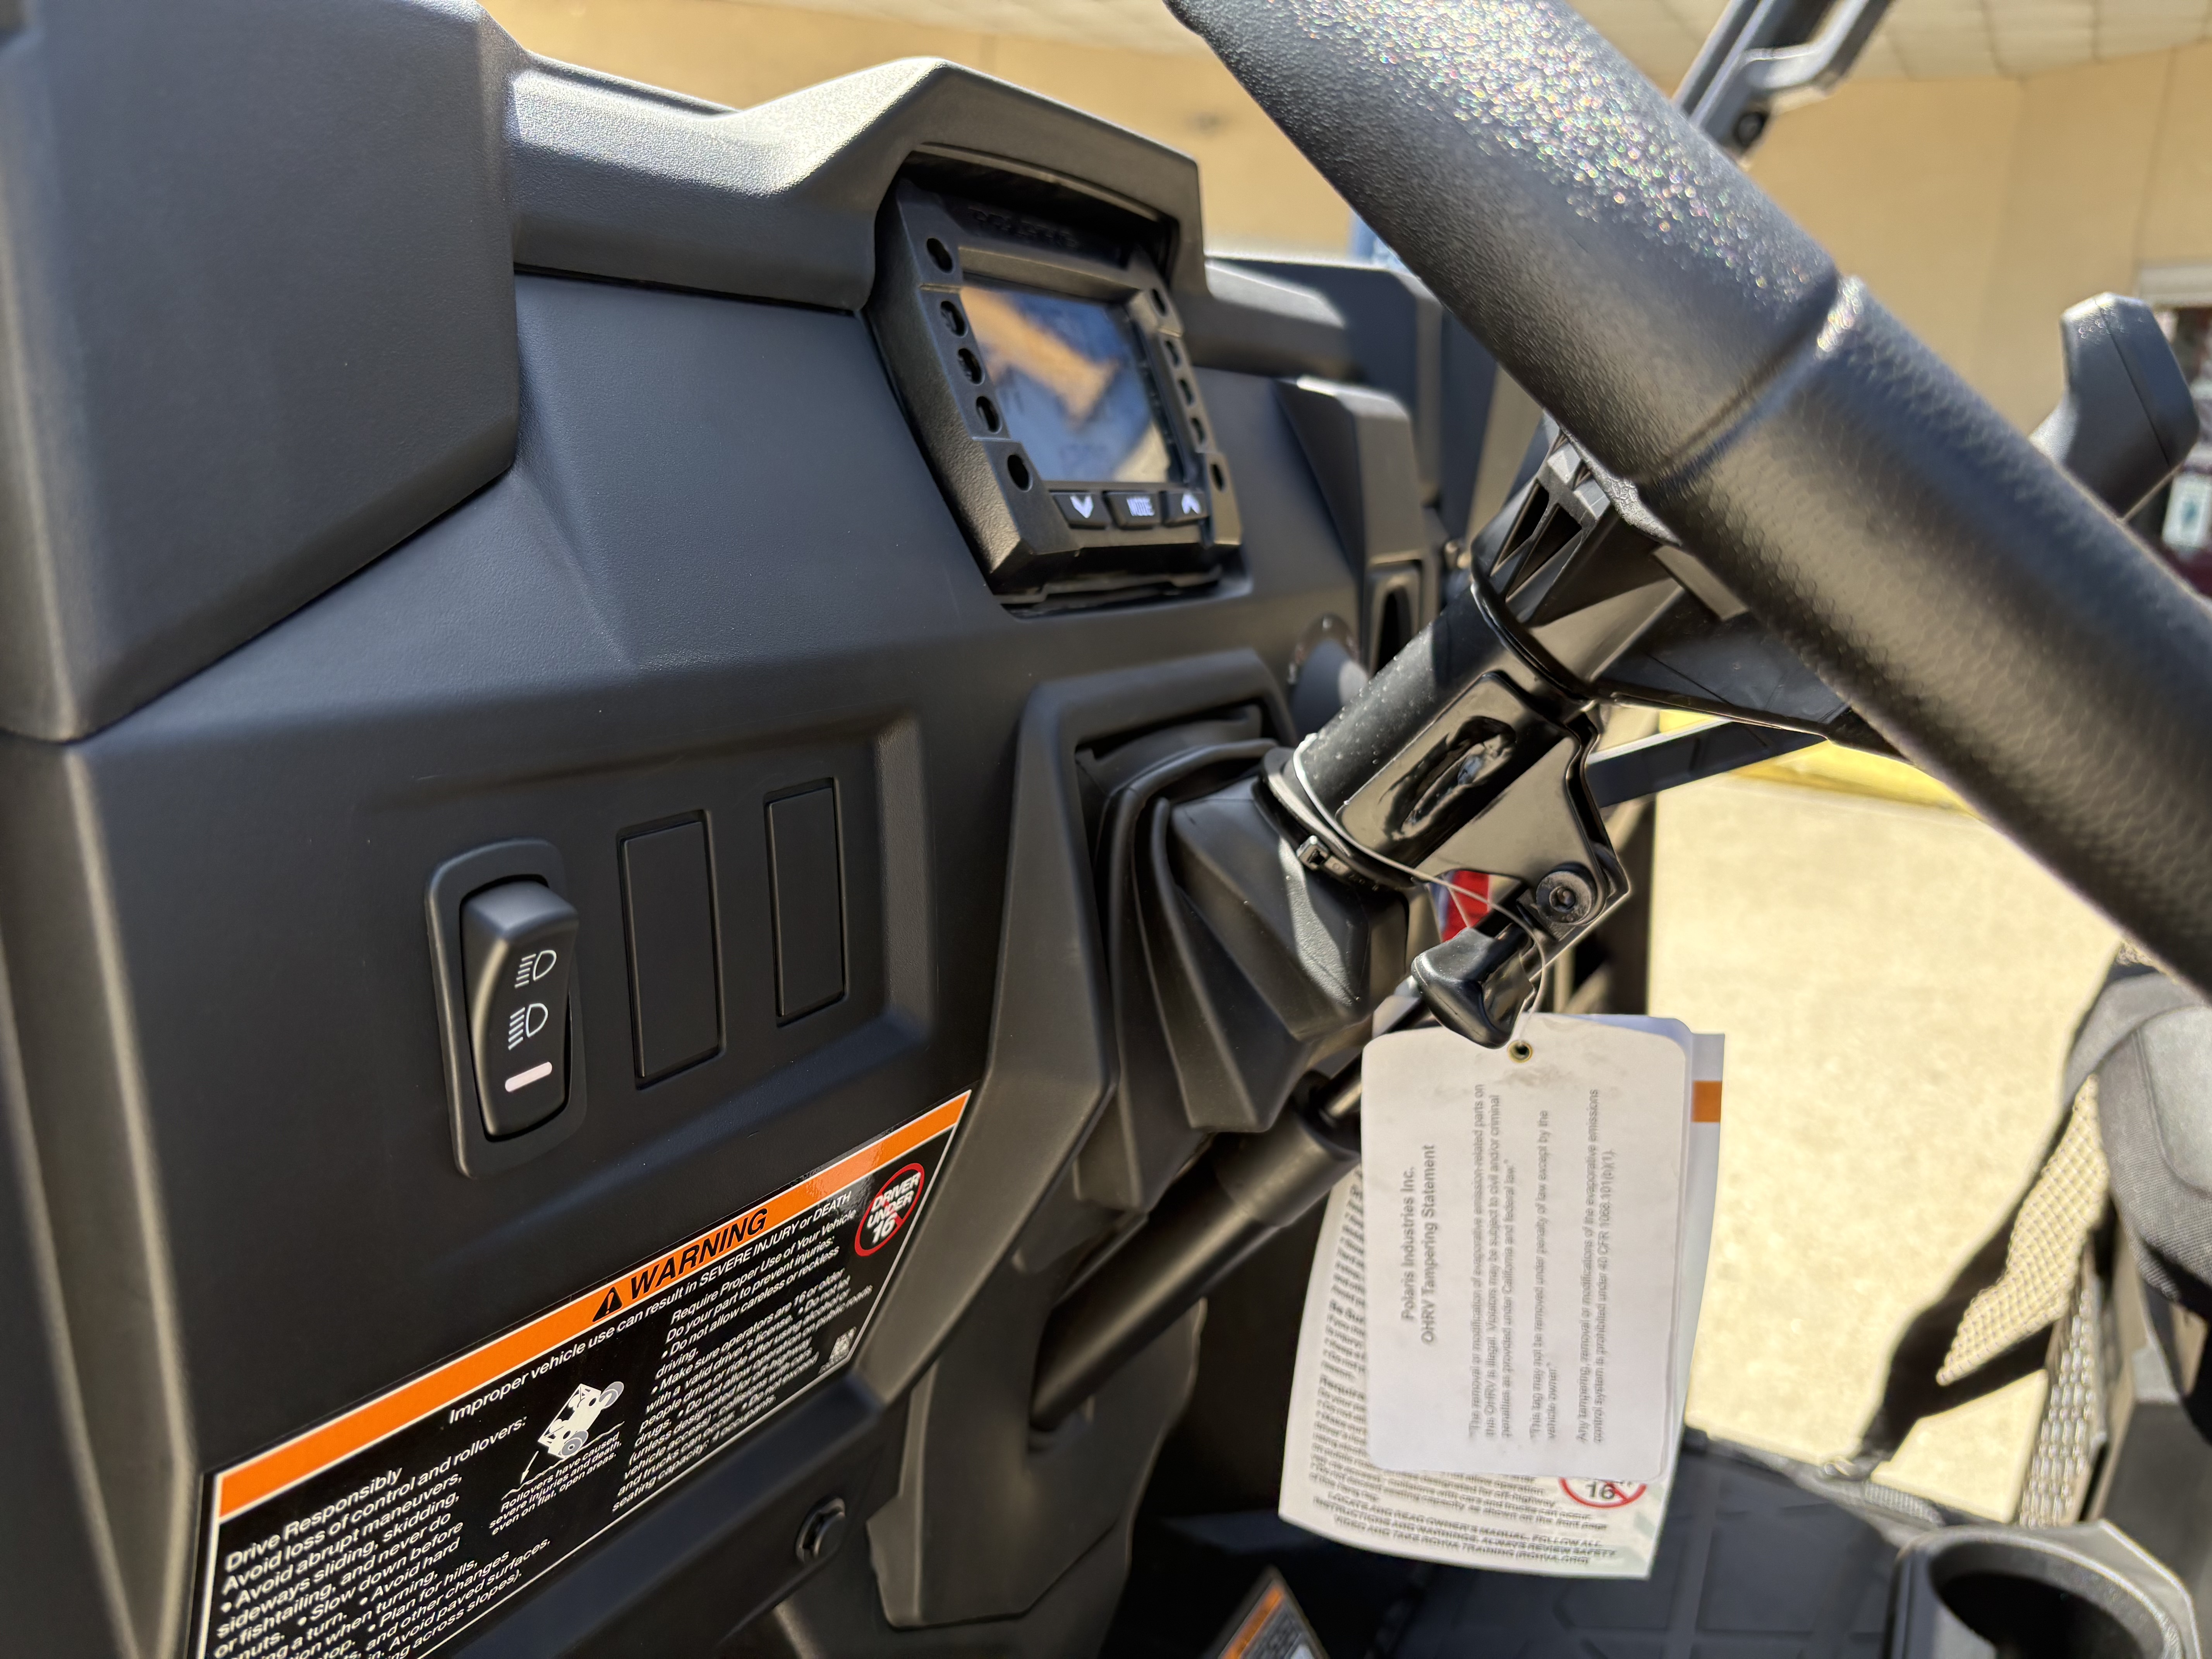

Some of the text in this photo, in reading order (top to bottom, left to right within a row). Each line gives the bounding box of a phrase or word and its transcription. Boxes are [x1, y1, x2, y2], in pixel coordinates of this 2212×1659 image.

[1475, 1084, 1484, 1098] on
[867, 1191, 914, 1228] UNDER
[871, 1173, 921, 1212] DRIVER
[873, 1212, 897, 1243] 16
[632, 1209, 767, 1298] WARNING
[671, 1206, 856, 1324] Require Proper Use of Your Vehicle
[1400, 1167, 1415, 1321] Polaris Industries Inc.
[1421, 1146, 1438, 1344] OHRV Tampering Statement
[450, 1191, 852, 1423] Improper vehicle use can result in SEVERE INJURY or DEATH
[666, 1236, 834, 1343] Do your part to prevent injuries:
[670, 1247, 839, 1356] Do not allow careless or reckless
[639, 1399, 682, 1433] people
[683, 1379, 712, 1403] drive
[713, 1369, 726, 1384] or
[726, 1356, 747, 1375] ride
[749, 1338, 774, 1360] after
[774, 1320, 802, 1344] using
[646, 1391, 671, 1413] with
[673, 1386, 680, 1397] a
[685, 1363, 713, 1389] valid
[713, 1339, 753, 1370] driver's
[655, 1348, 698, 1379] driving.
[660, 1364, 693, 1391] Make
[694, 1348, 720, 1369] sure
[721, 1314, 773, 1352] operators
[774, 1302, 792, 1319] are
[794, 1291, 806, 1306] 16
[807, 1285, 818, 1298] or
[625, 1447, 666, 1479] vehicle
[668, 1414, 711, 1450] access)
[629, 1431, 672, 1465] (unless
[673, 1386, 736, 1434] designated
[736, 1376, 752, 1392] for
[635, 1419, 671, 1447] drugs.
[685, 1398, 702, 1415] Do
[703, 1383, 722, 1402] not
[723, 1365, 752, 1389] allow
[223, 1417, 526, 1594] Avoid loss of control and rollovers:
[489, 1501, 527, 1528] severe
[529, 1474, 568, 1503] injuries
[570, 1458, 591, 1477] and
[492, 1514, 519, 1535] even
[521, 1503, 535, 1516] on
[559, 1472, 585, 1492] open
[587, 1453, 616, 1474] areas.
[501, 1432, 619, 1512] Rollovers have caused
[613, 1477, 656, 1511] seating
[618, 1472, 642, 1496] and
[644, 1449, 679, 1479] trucks
[681, 1434, 701, 1453] can
[1584, 1480, 1616, 1500] 16
[226, 1468, 401, 1571] Drive Responsibly
[235, 1474, 461, 1608] Avoid abrupt maneuvers,
[214, 1638, 237, 1658] or
[240, 1584, 335, 1644] fishtailing,
[340, 1555, 375, 1585] and
[378, 1527, 427, 1563] never
[429, 1513, 450, 1532] do
[218, 1493, 459, 1638] sideways sliding, skidding,
[237, 1633, 284, 1659] nuts.
[310, 1587, 356, 1620] Slow
[359, 1557, 406, 1591] down
[410, 1523, 463, 1560] before
[291, 1537, 460, 1650] a turn. Avoid hard
[326, 1571, 437, 1645] when turning,
[366, 1552, 509, 1651] and other changes
[380, 1599, 416, 1627] Plan
[419, 1581, 442, 1602] for
[444, 1561, 477, 1586] hills,
[389, 1612, 435, 1651] Avoid
[437, 1579, 485, 1621] paved
[413, 1570, 521, 1648] across slopes).
